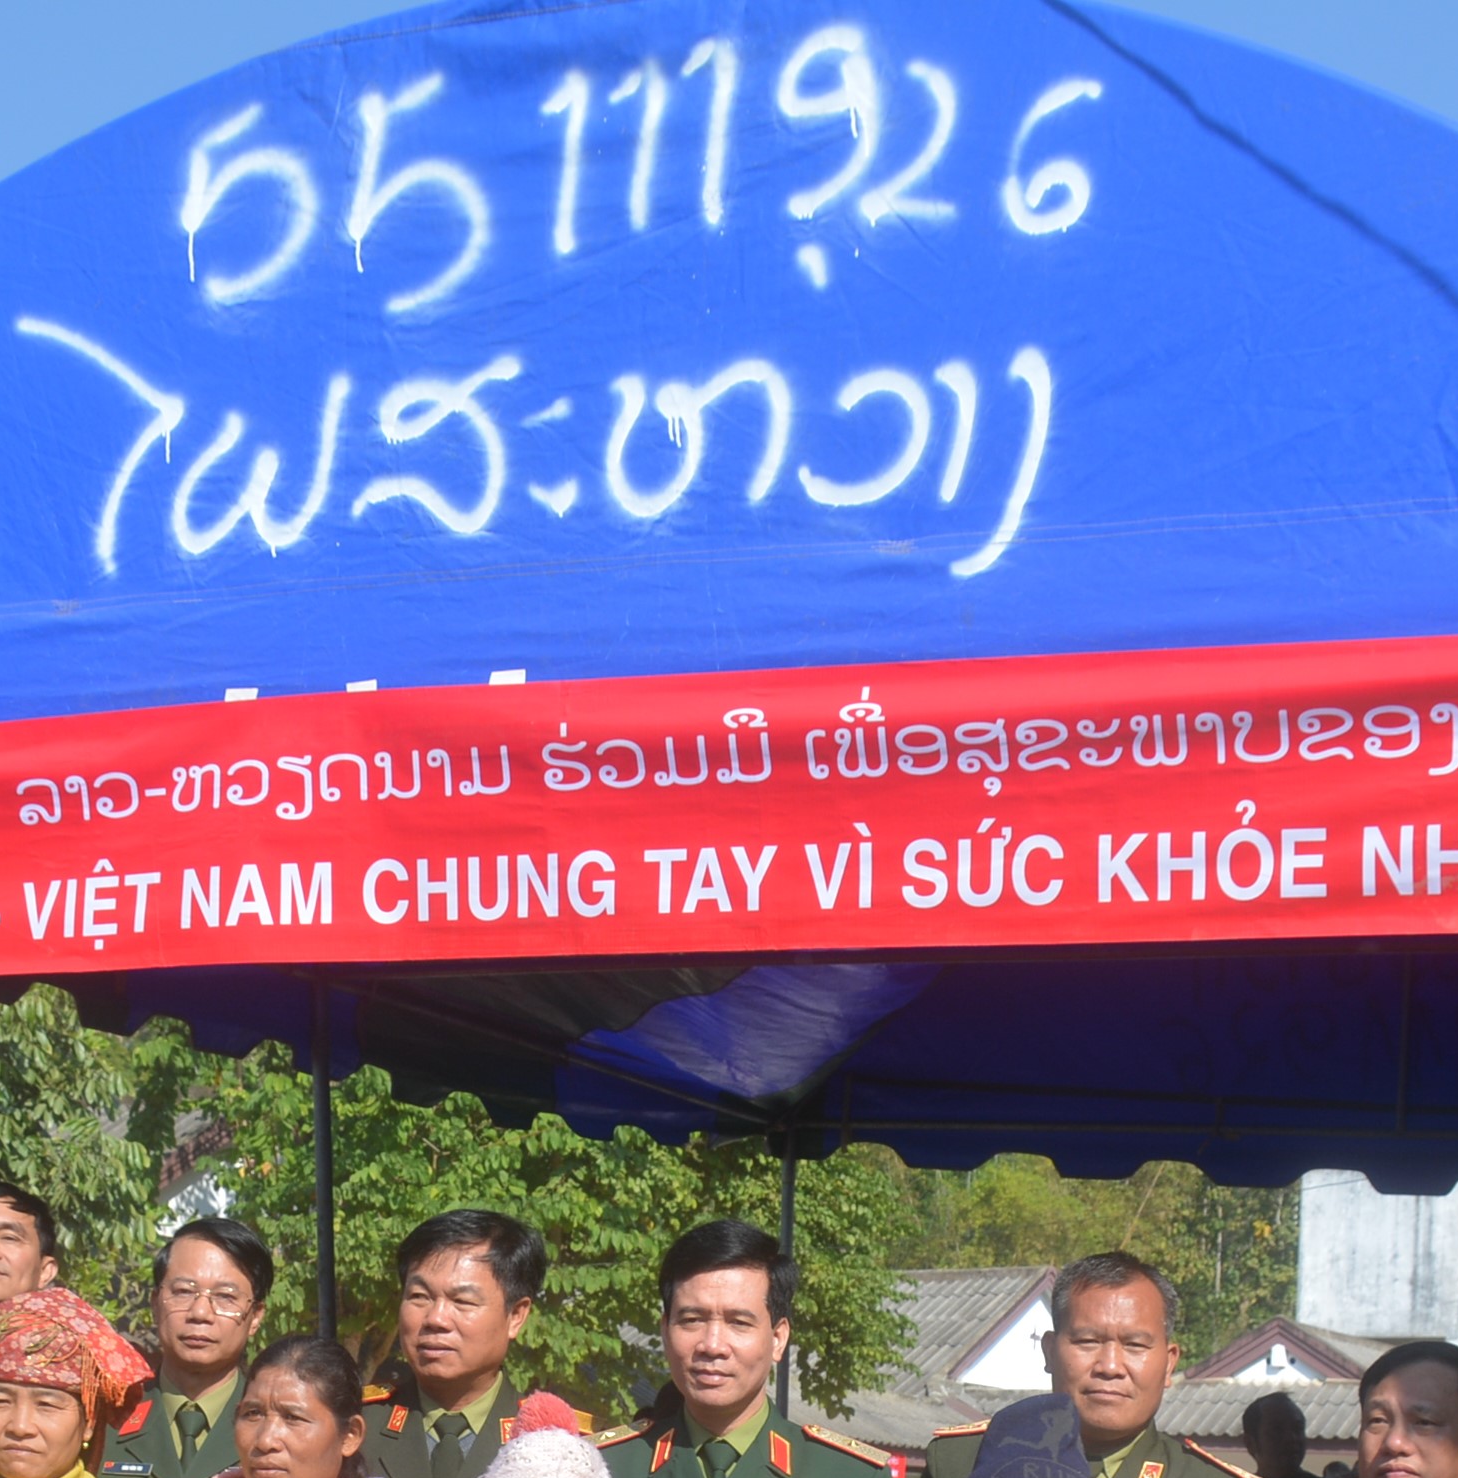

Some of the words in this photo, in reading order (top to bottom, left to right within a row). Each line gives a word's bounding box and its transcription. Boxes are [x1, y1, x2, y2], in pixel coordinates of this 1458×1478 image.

[22, 858, 161, 951] VIỆT
[181, 862, 334, 930] NAM
[362, 849, 617, 925] CHUNG
[644, 845, 778, 914] TAY
[804, 822, 874, 910] VÌ
[901, 817, 1065, 909] SỨC
[1097, 799, 1327, 904] KHỎE
